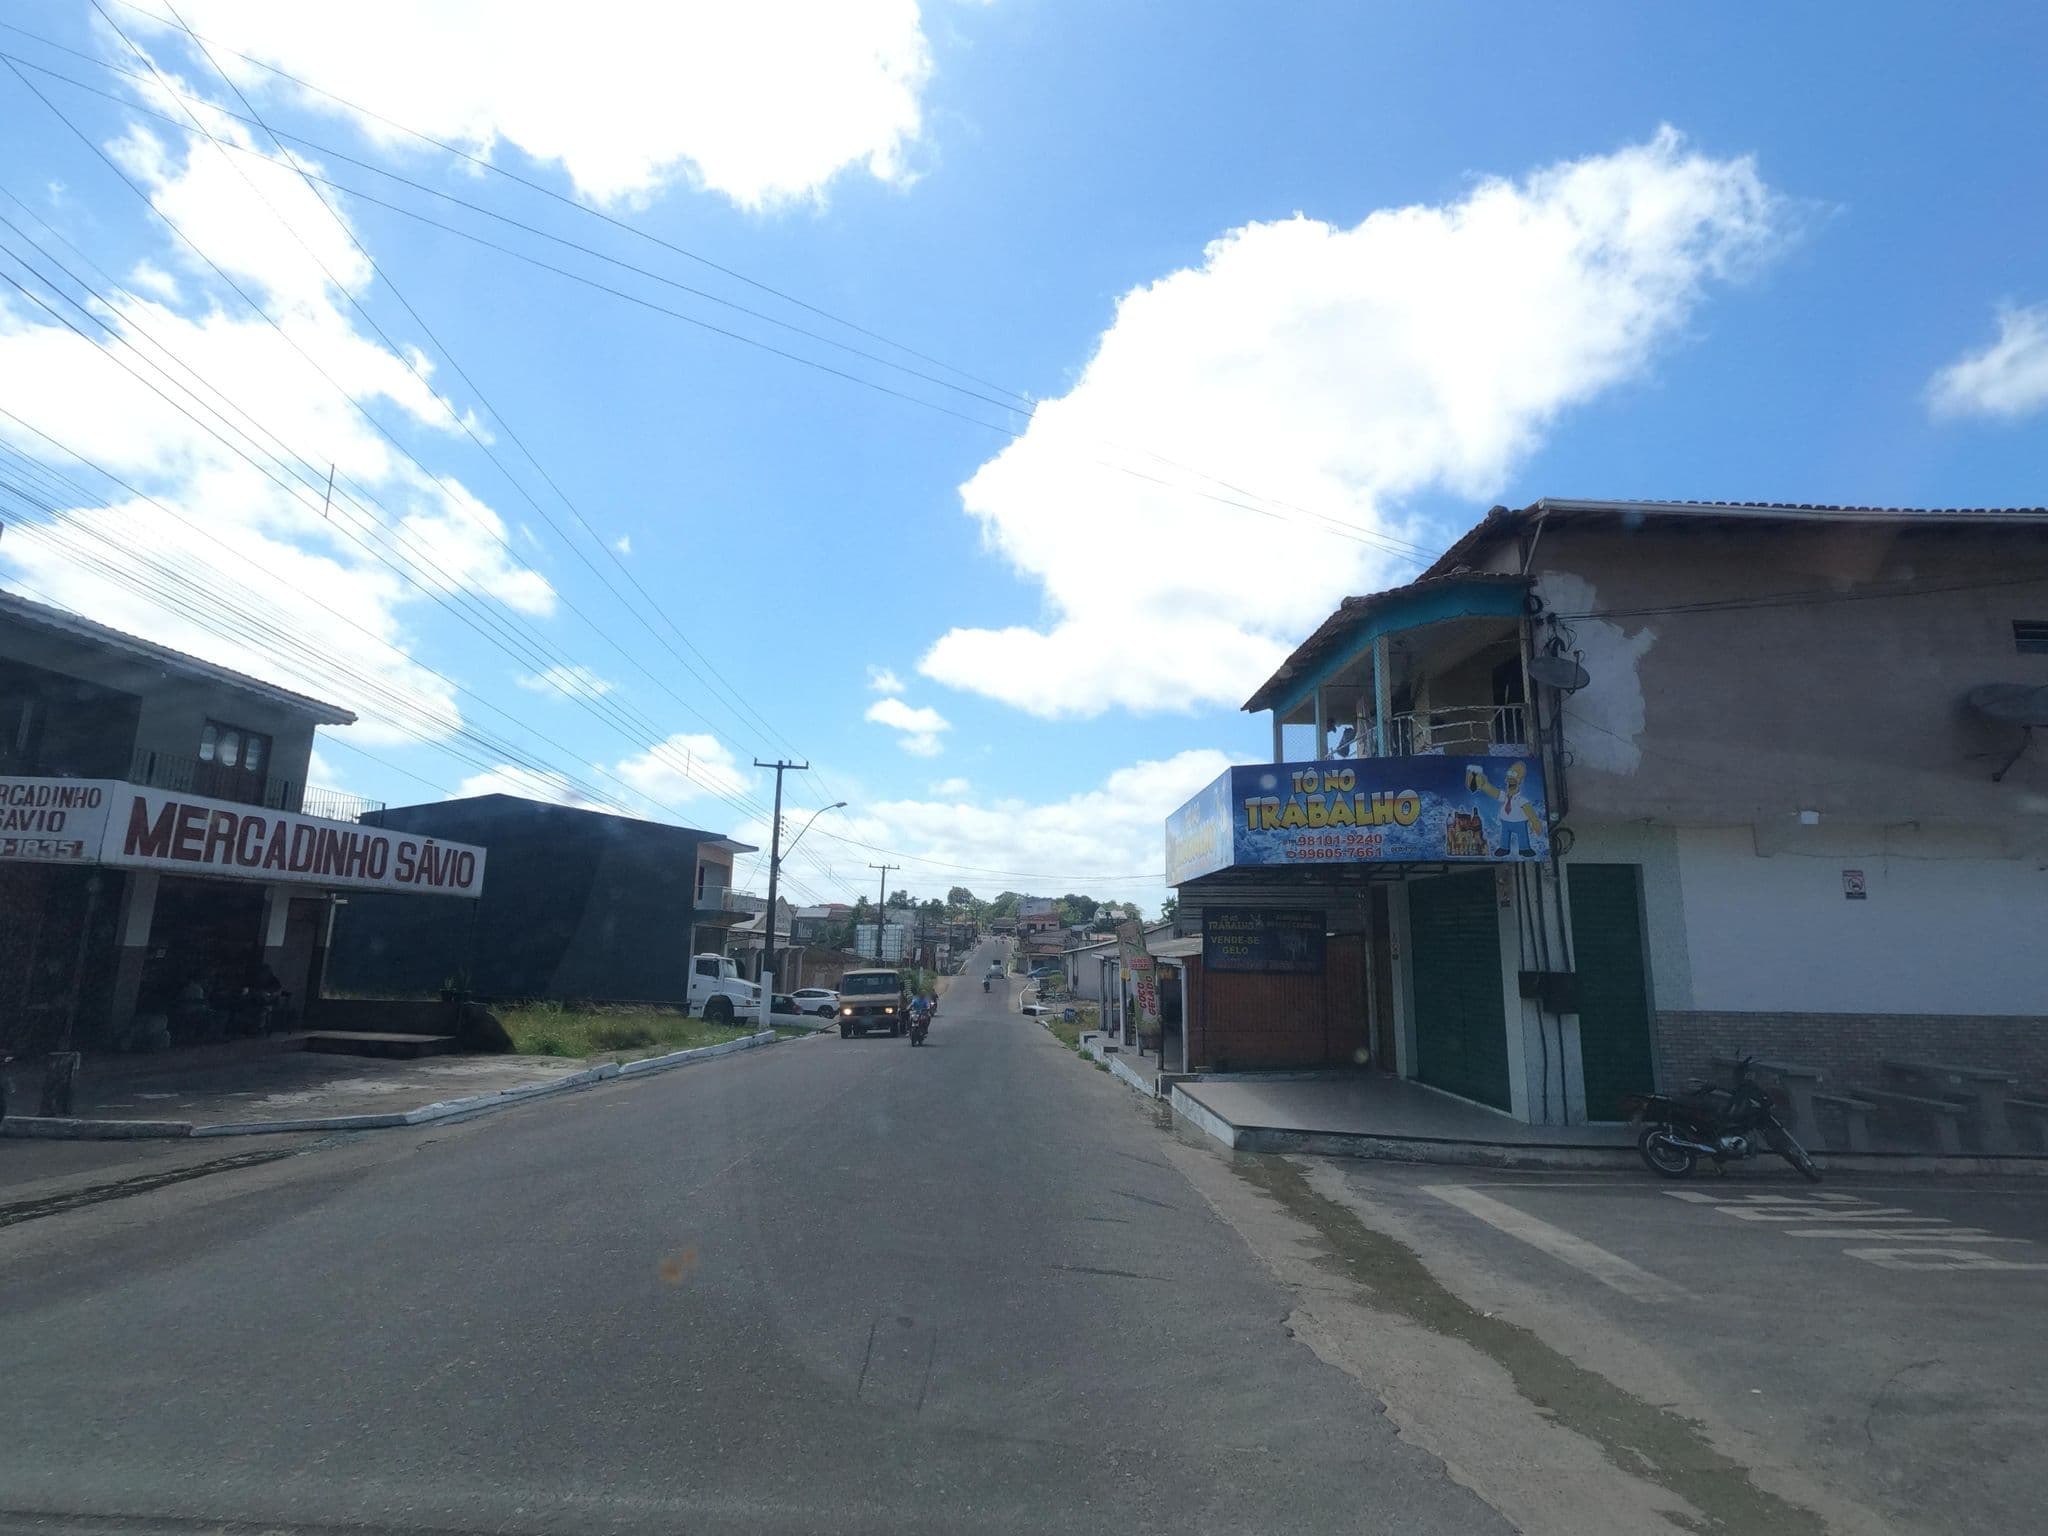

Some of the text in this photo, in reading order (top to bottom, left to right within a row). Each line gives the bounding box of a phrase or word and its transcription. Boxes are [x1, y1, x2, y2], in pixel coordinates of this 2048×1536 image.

[1292, 767, 1356, 794] TÔ NO
[1245, 789, 1421, 830] TRABALHO
[124, 796, 390, 879] MERCADINHO
[1297, 834, 1383, 846] 98101-9240
[1299, 848, 1382, 859] 99605-7661
[1210, 935, 1261, 945] VENDE-SE
[1221, 946, 1249, 955] GELO
[1136, 982, 1148, 1009] COCO
[1145, 975, 1157, 1016] GELADO
